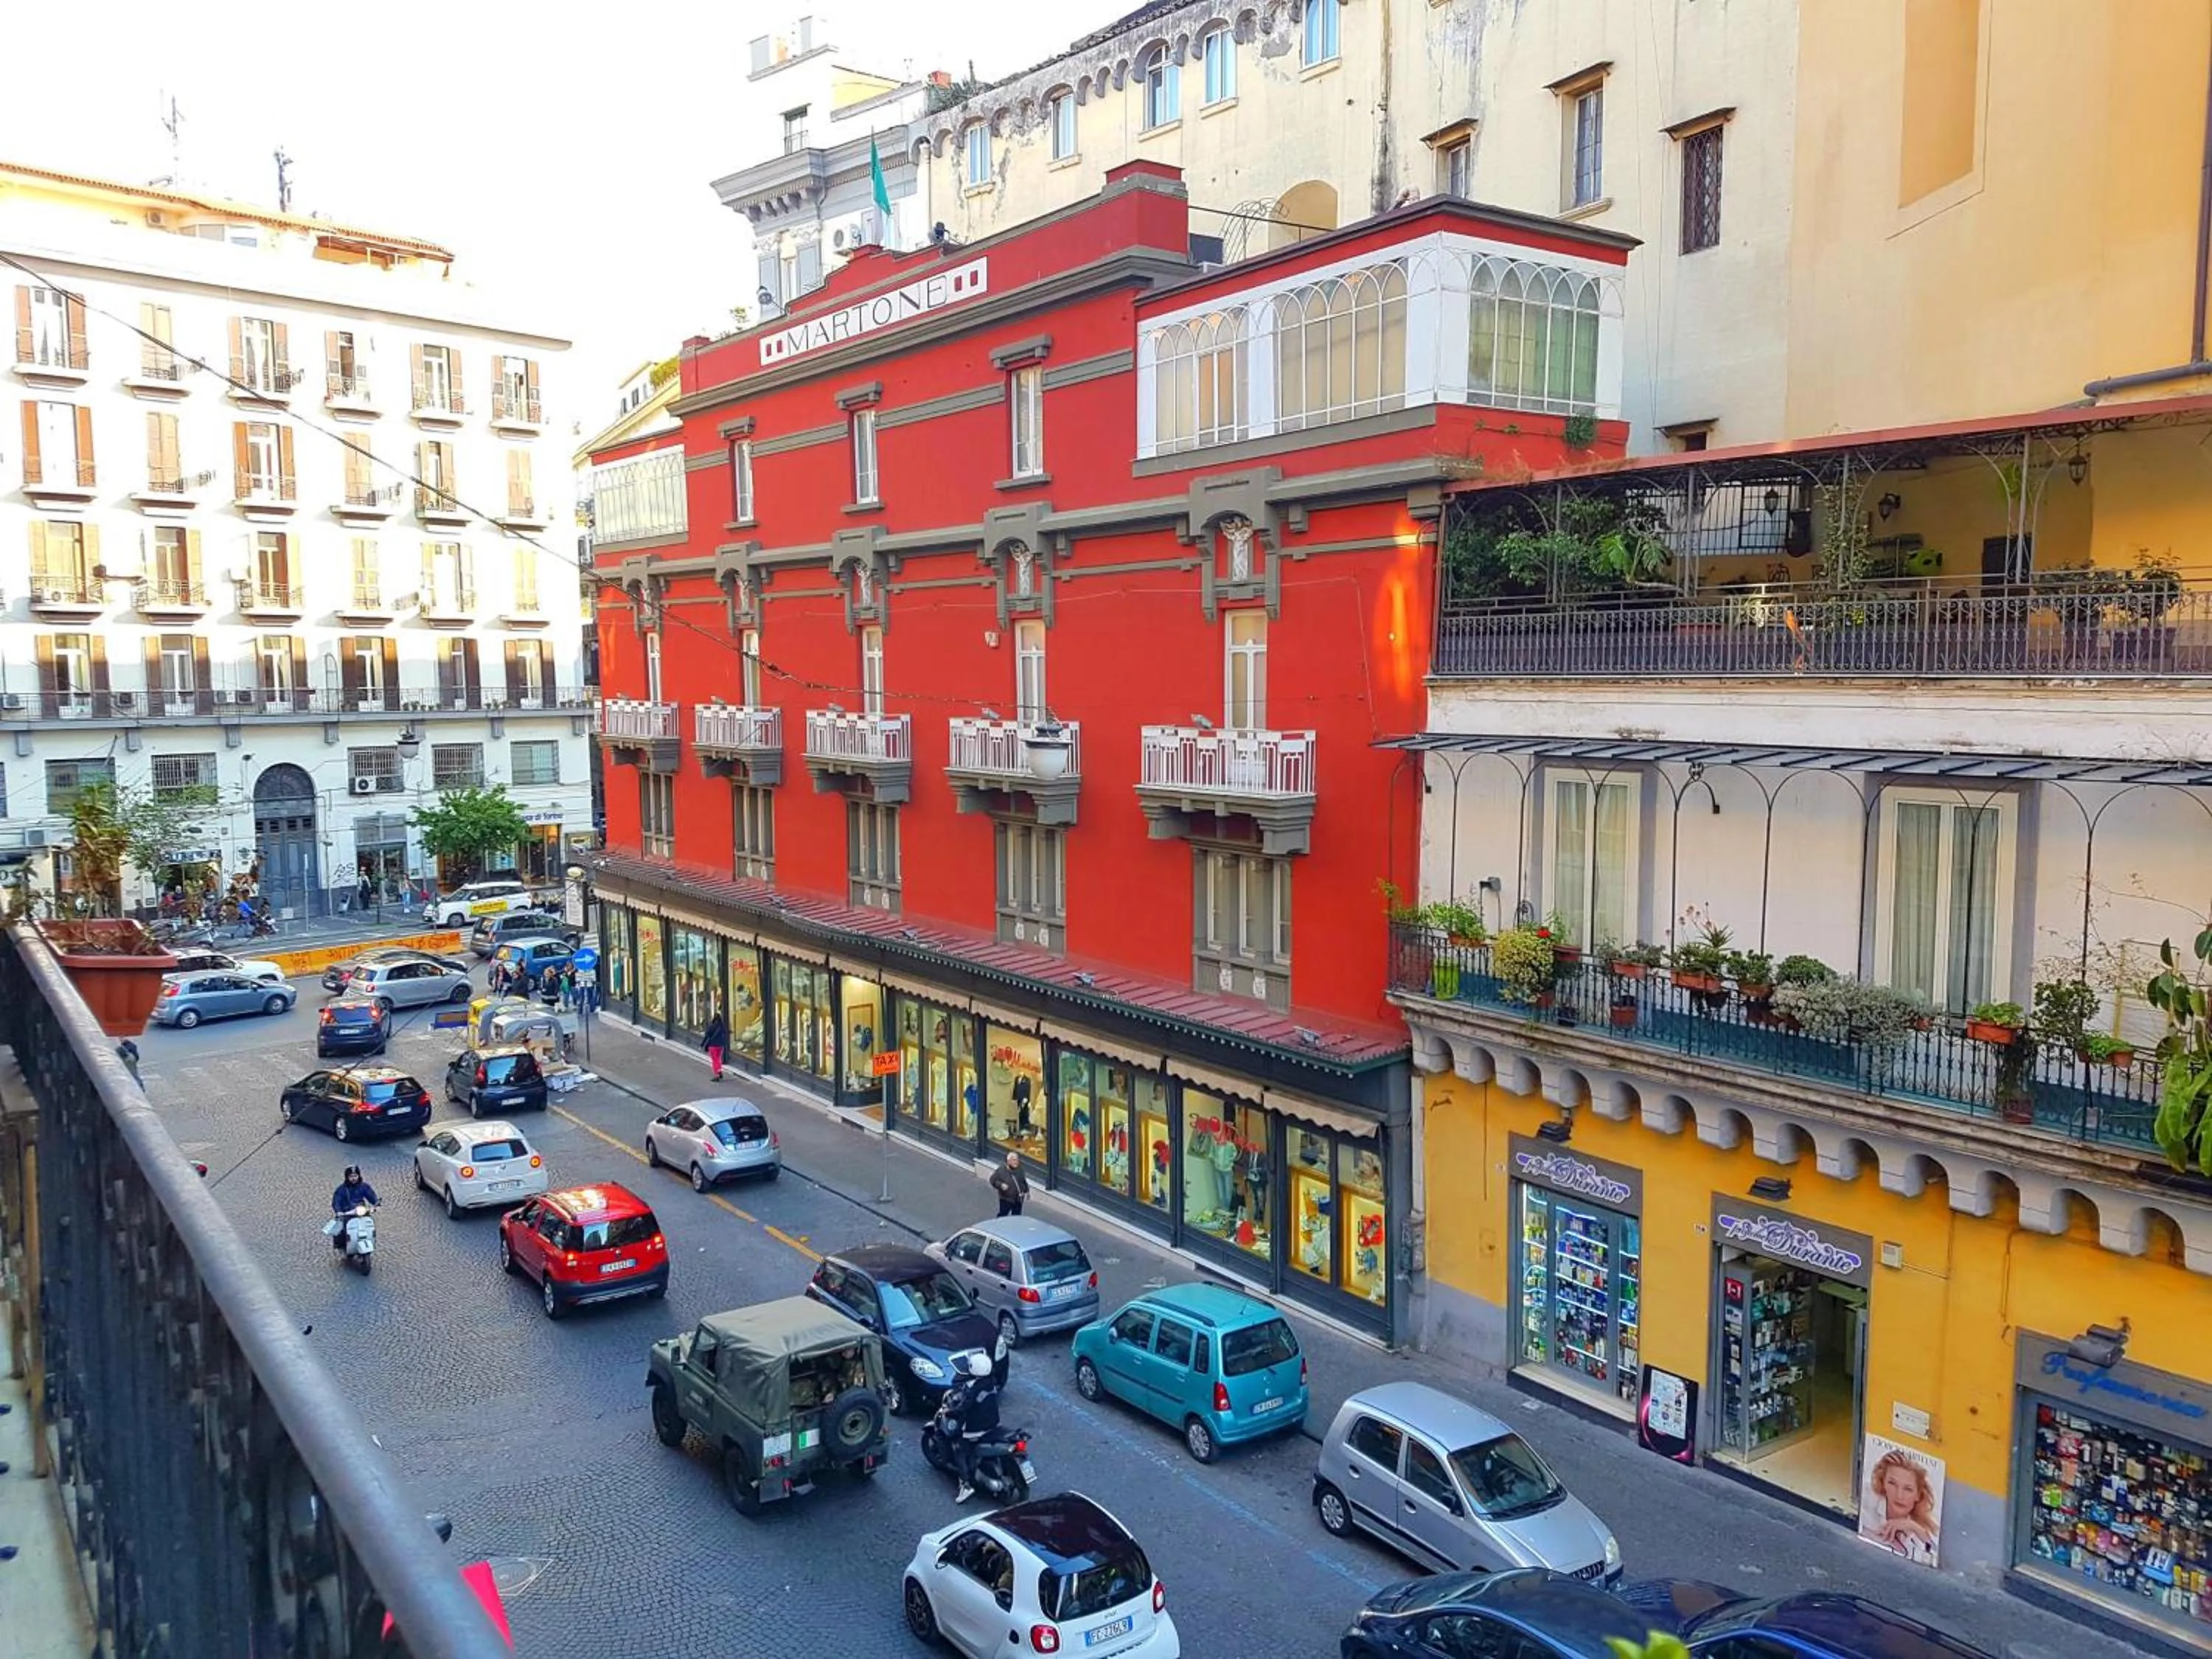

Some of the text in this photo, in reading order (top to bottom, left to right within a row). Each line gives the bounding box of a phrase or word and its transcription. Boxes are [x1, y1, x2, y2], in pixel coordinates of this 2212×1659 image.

[787, 275, 948, 356] MARTONE
[874, 1054, 898, 1065] TAXI
[1763, 1221, 1854, 1273] Durante
